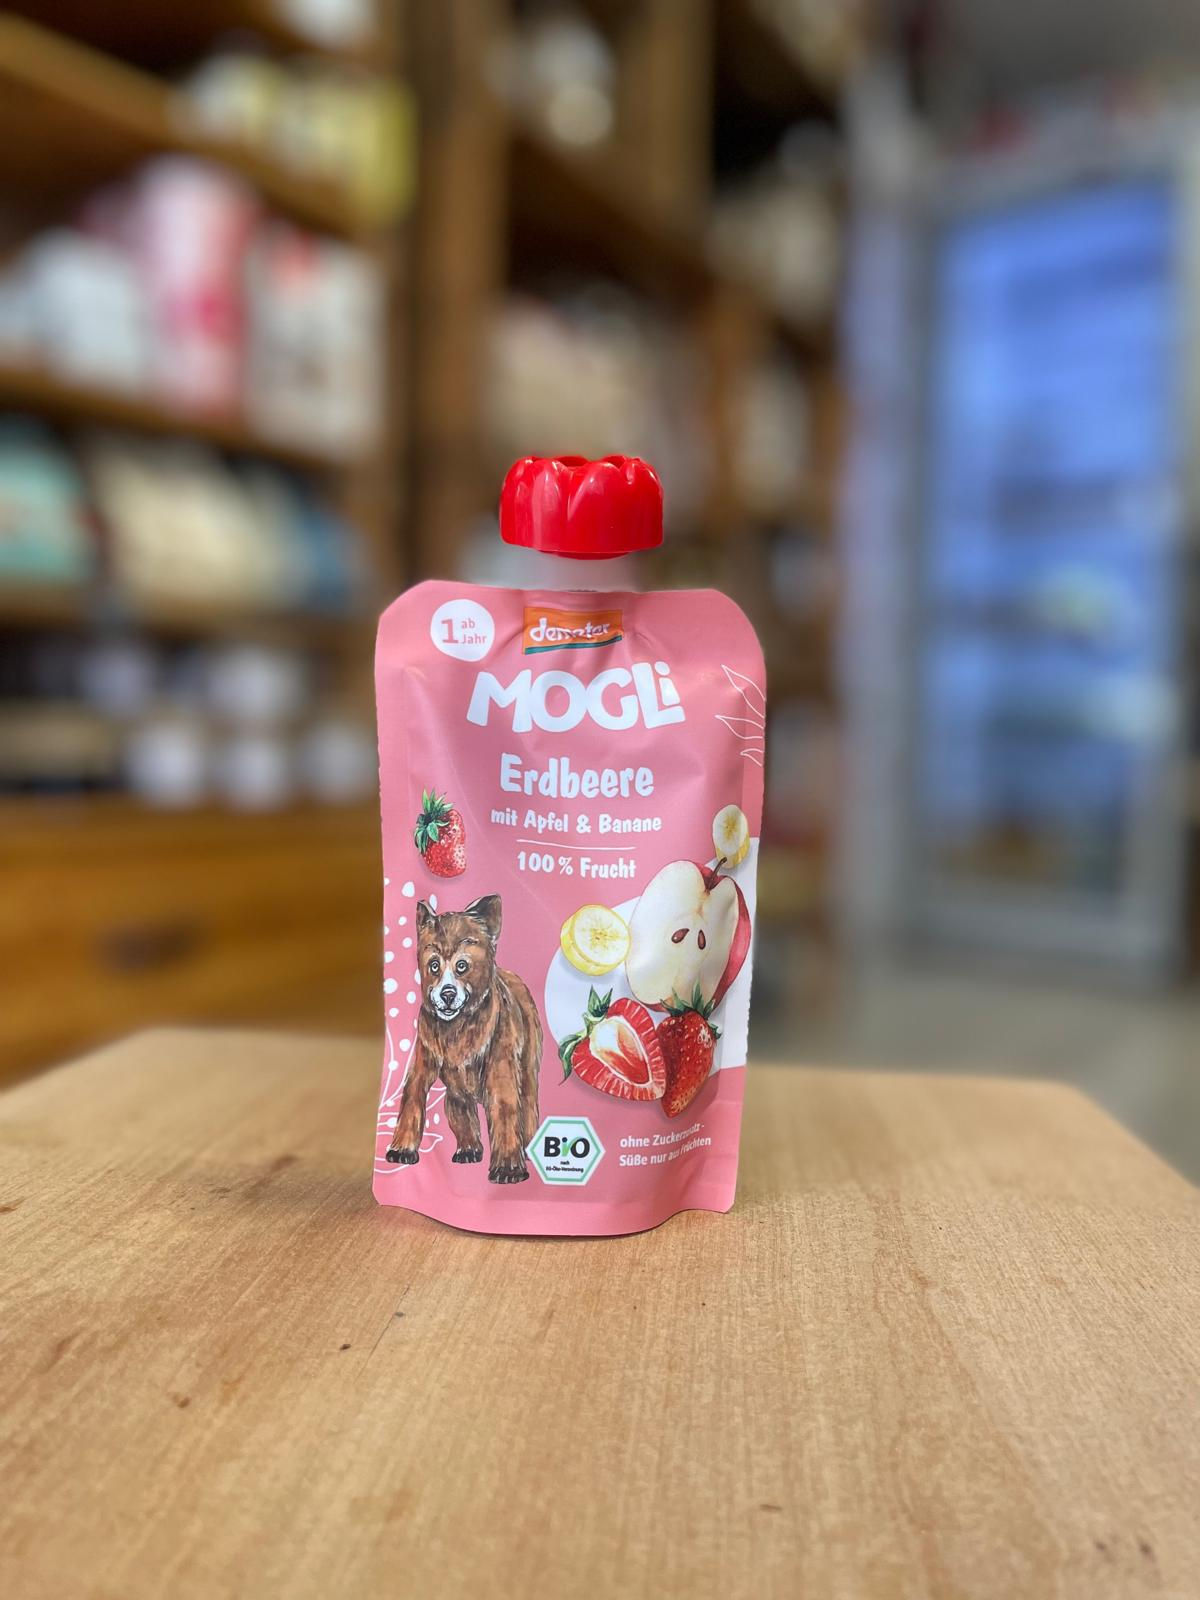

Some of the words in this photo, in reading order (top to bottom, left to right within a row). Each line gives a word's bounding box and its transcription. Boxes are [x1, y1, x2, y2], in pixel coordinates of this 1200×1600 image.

[441, 619, 459, 644] 1
[461, 617, 476, 629] ab
[460, 633, 487, 645] Jahr
[500, 752, 654, 798] Erdbeere
[490, 807, 518, 826] mit
[523, 809, 569, 834] Apfel
[575, 814, 592, 834] &
[598, 813, 662, 834] Banane
[517, 851, 554, 873] 100
[580, 857, 637, 879] Frucht
[620, 1135, 650, 1148] ohne
[619, 1154, 648, 1167] Süße
[650, 1153, 668, 1165] nur
